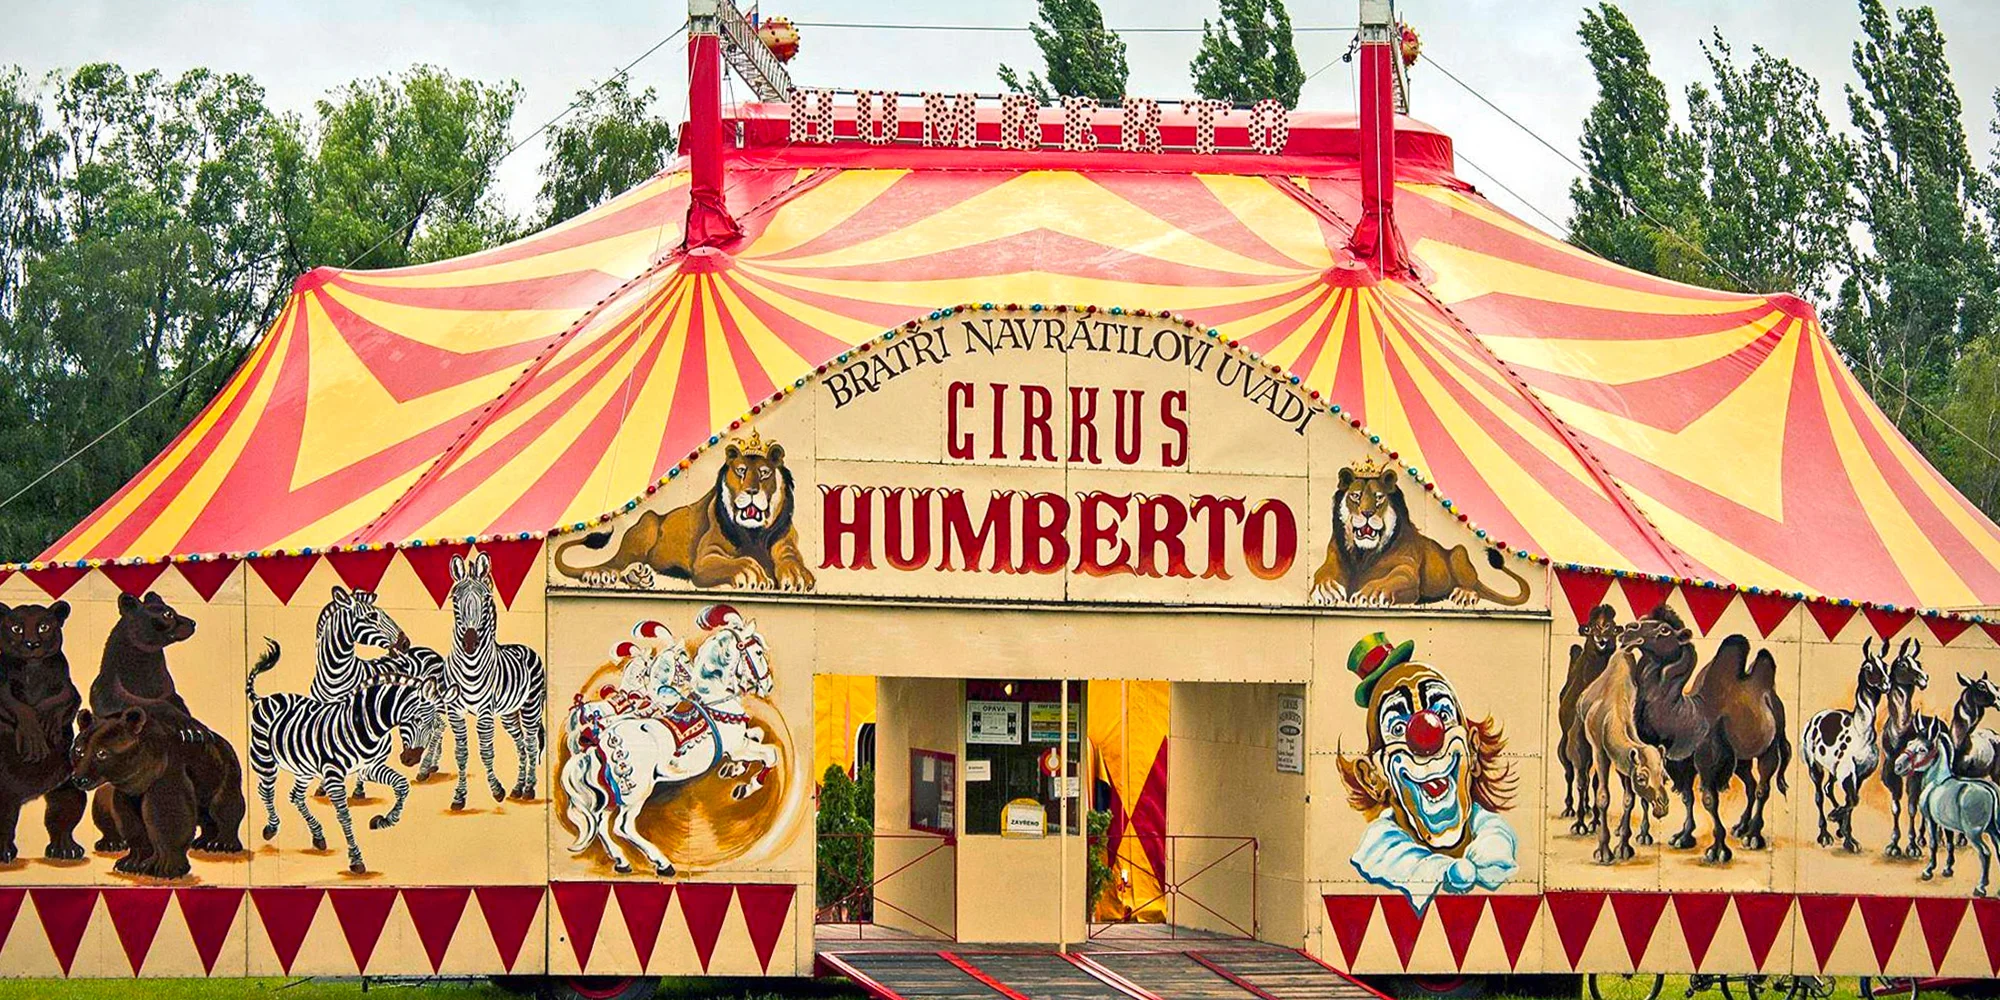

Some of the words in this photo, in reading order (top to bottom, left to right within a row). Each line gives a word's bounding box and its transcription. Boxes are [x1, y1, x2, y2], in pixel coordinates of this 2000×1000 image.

[787, 88, 1290, 155] HUMBERTO
[822, 325, 951, 409] BRATŘI
[961, 315, 1213, 373] NAVRÁTILOVI
[1216, 352, 1324, 436] UVÁDÍ
[947, 381, 1188, 468] CIRKUS
[816, 484, 1298, 580] HUMBERTO
